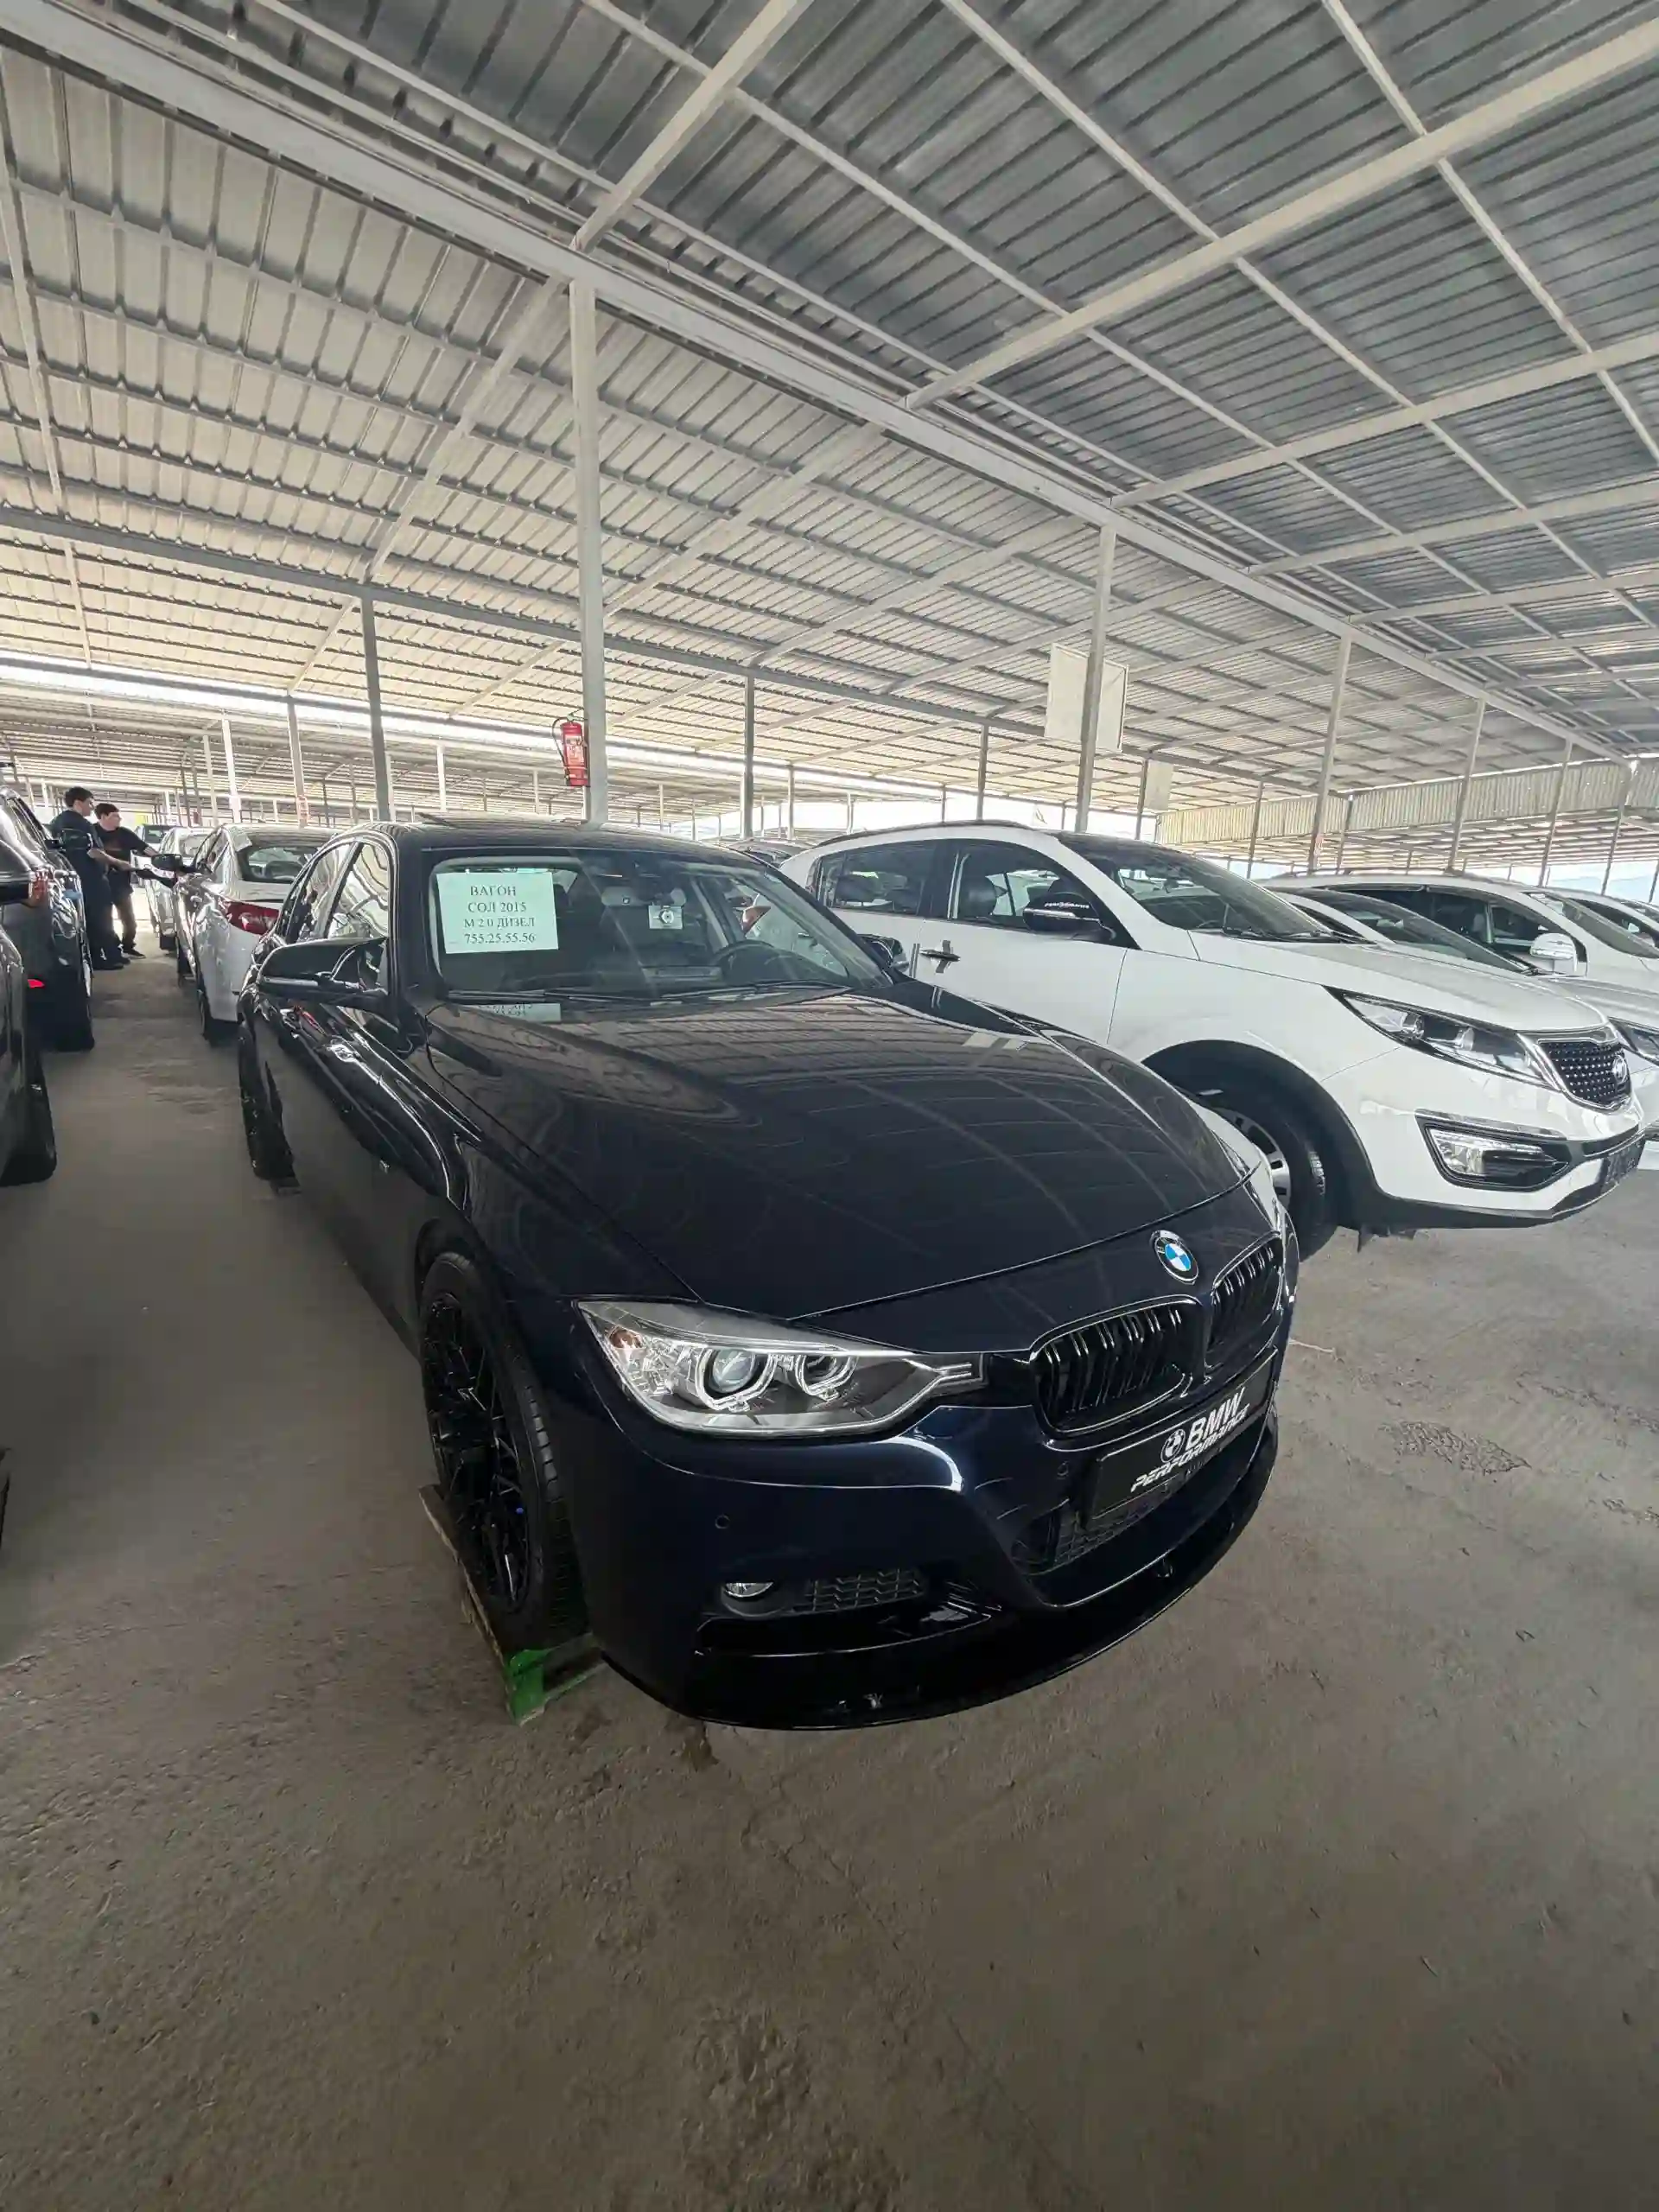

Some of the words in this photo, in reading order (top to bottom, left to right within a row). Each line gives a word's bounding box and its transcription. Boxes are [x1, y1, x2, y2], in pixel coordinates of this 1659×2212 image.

[470, 886, 516, 896] ВАГОН
[467, 902, 496, 913] СОЛ
[500, 901, 527, 912] 2015
[1185, 1386, 1246, 1451] BMW
